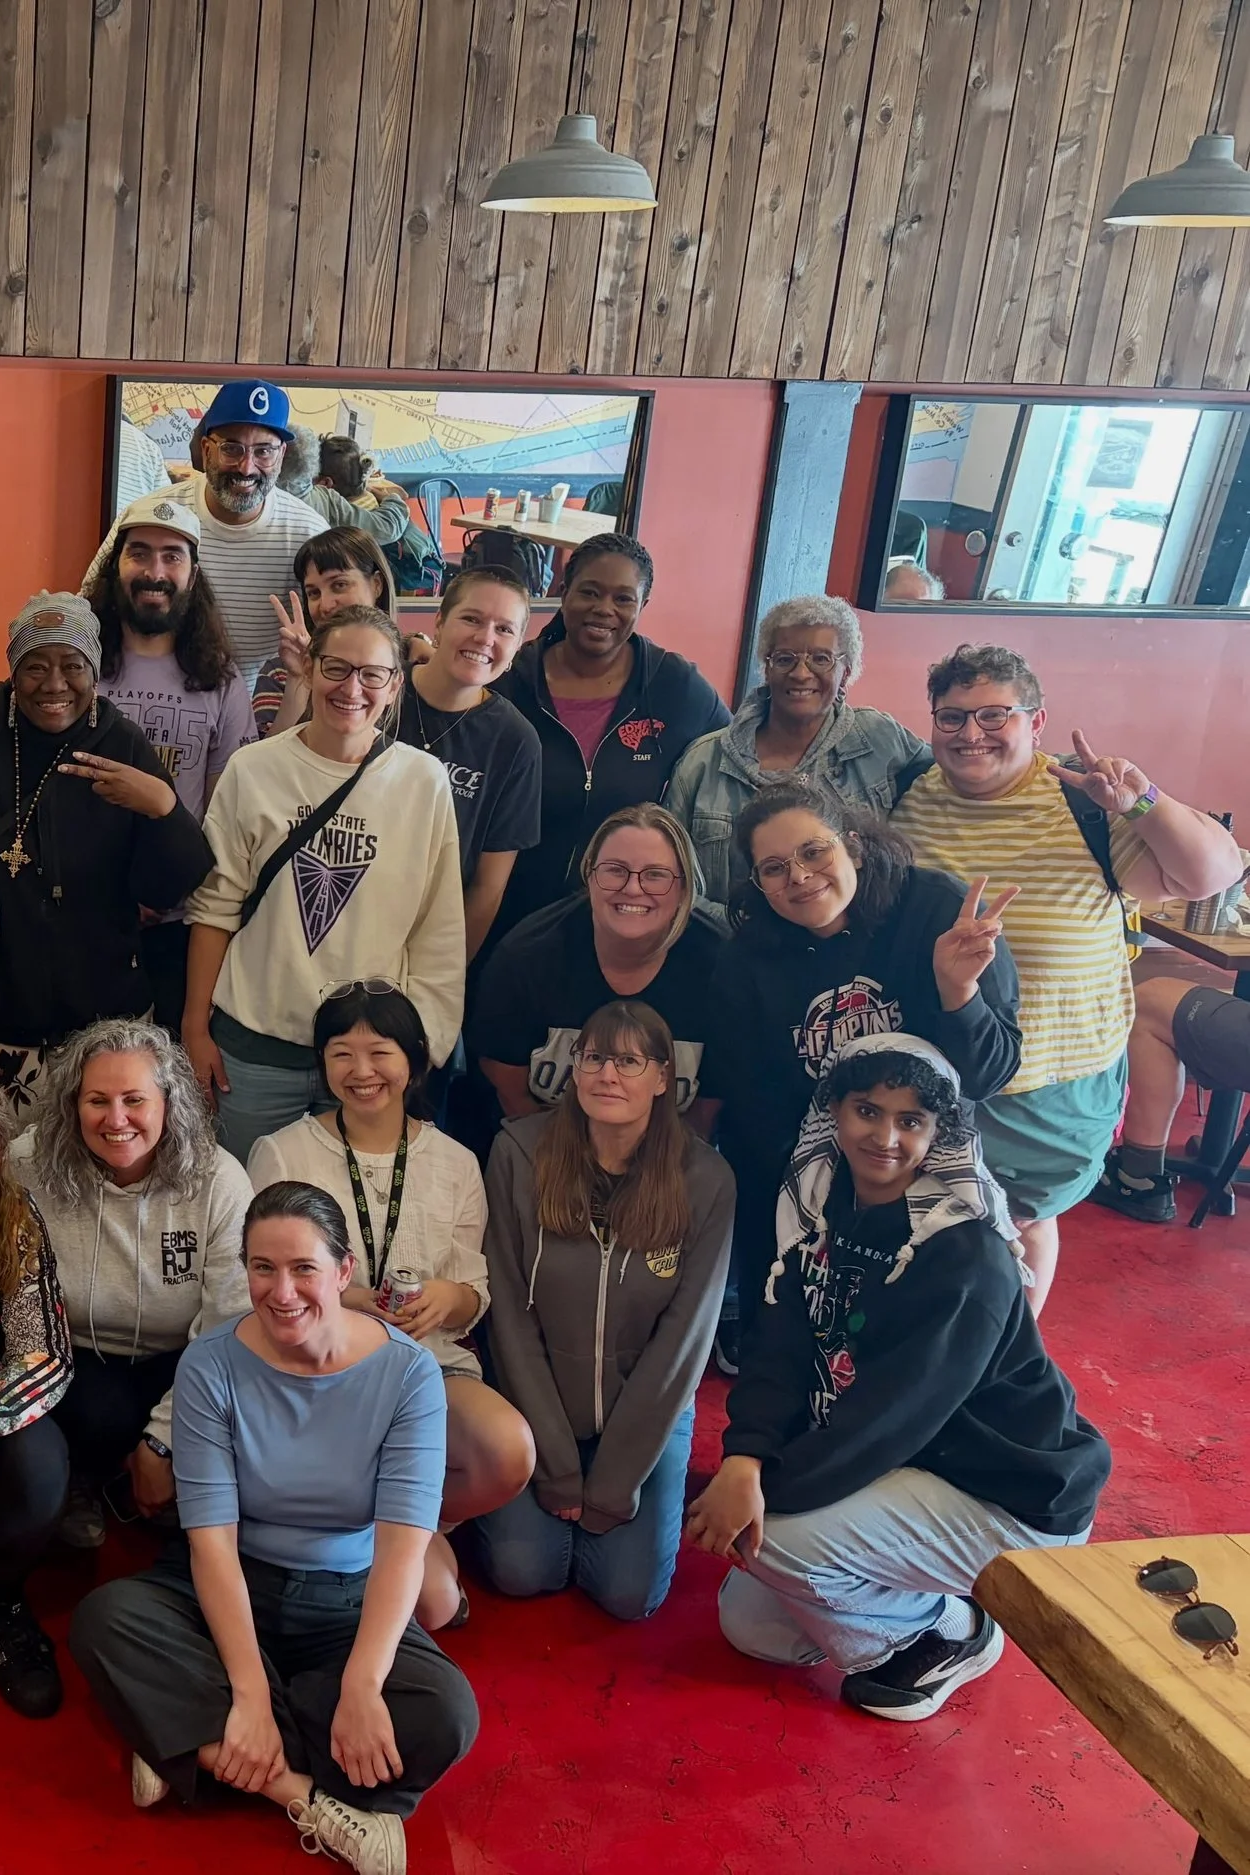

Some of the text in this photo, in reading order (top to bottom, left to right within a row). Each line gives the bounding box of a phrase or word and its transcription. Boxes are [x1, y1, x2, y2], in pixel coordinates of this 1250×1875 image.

[249, 387, 269, 415] O
[108, 690, 182, 704] PLAYOFFS
[331, 813, 366, 832] STATE
[161, 1230, 198, 1249] EBMS
[162, 1247, 198, 1276] RJ
